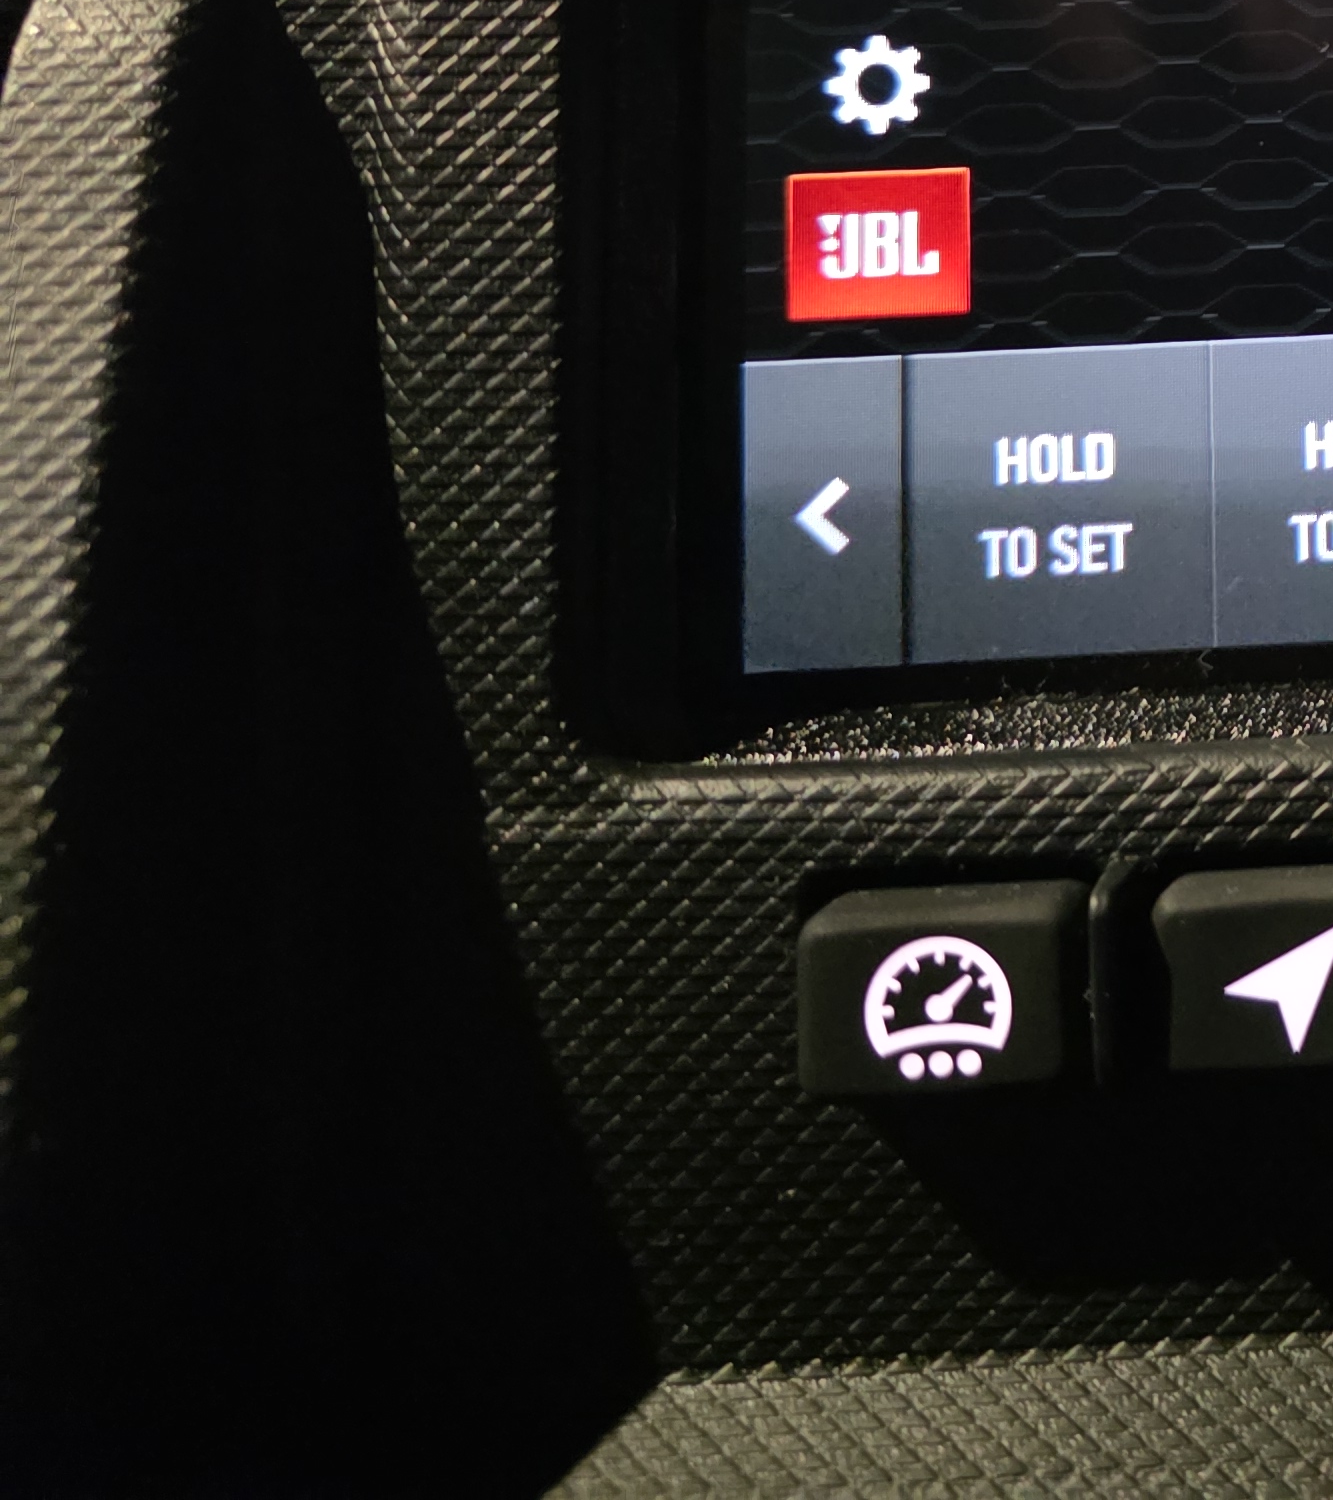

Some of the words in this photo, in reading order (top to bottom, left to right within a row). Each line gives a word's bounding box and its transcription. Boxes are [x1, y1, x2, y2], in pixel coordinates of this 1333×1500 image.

[817, 209, 941, 281] JBL
[995, 430, 1117, 486] HOLD
[980, 525, 1038, 578] TO
[1050, 521, 1134, 576] SET
